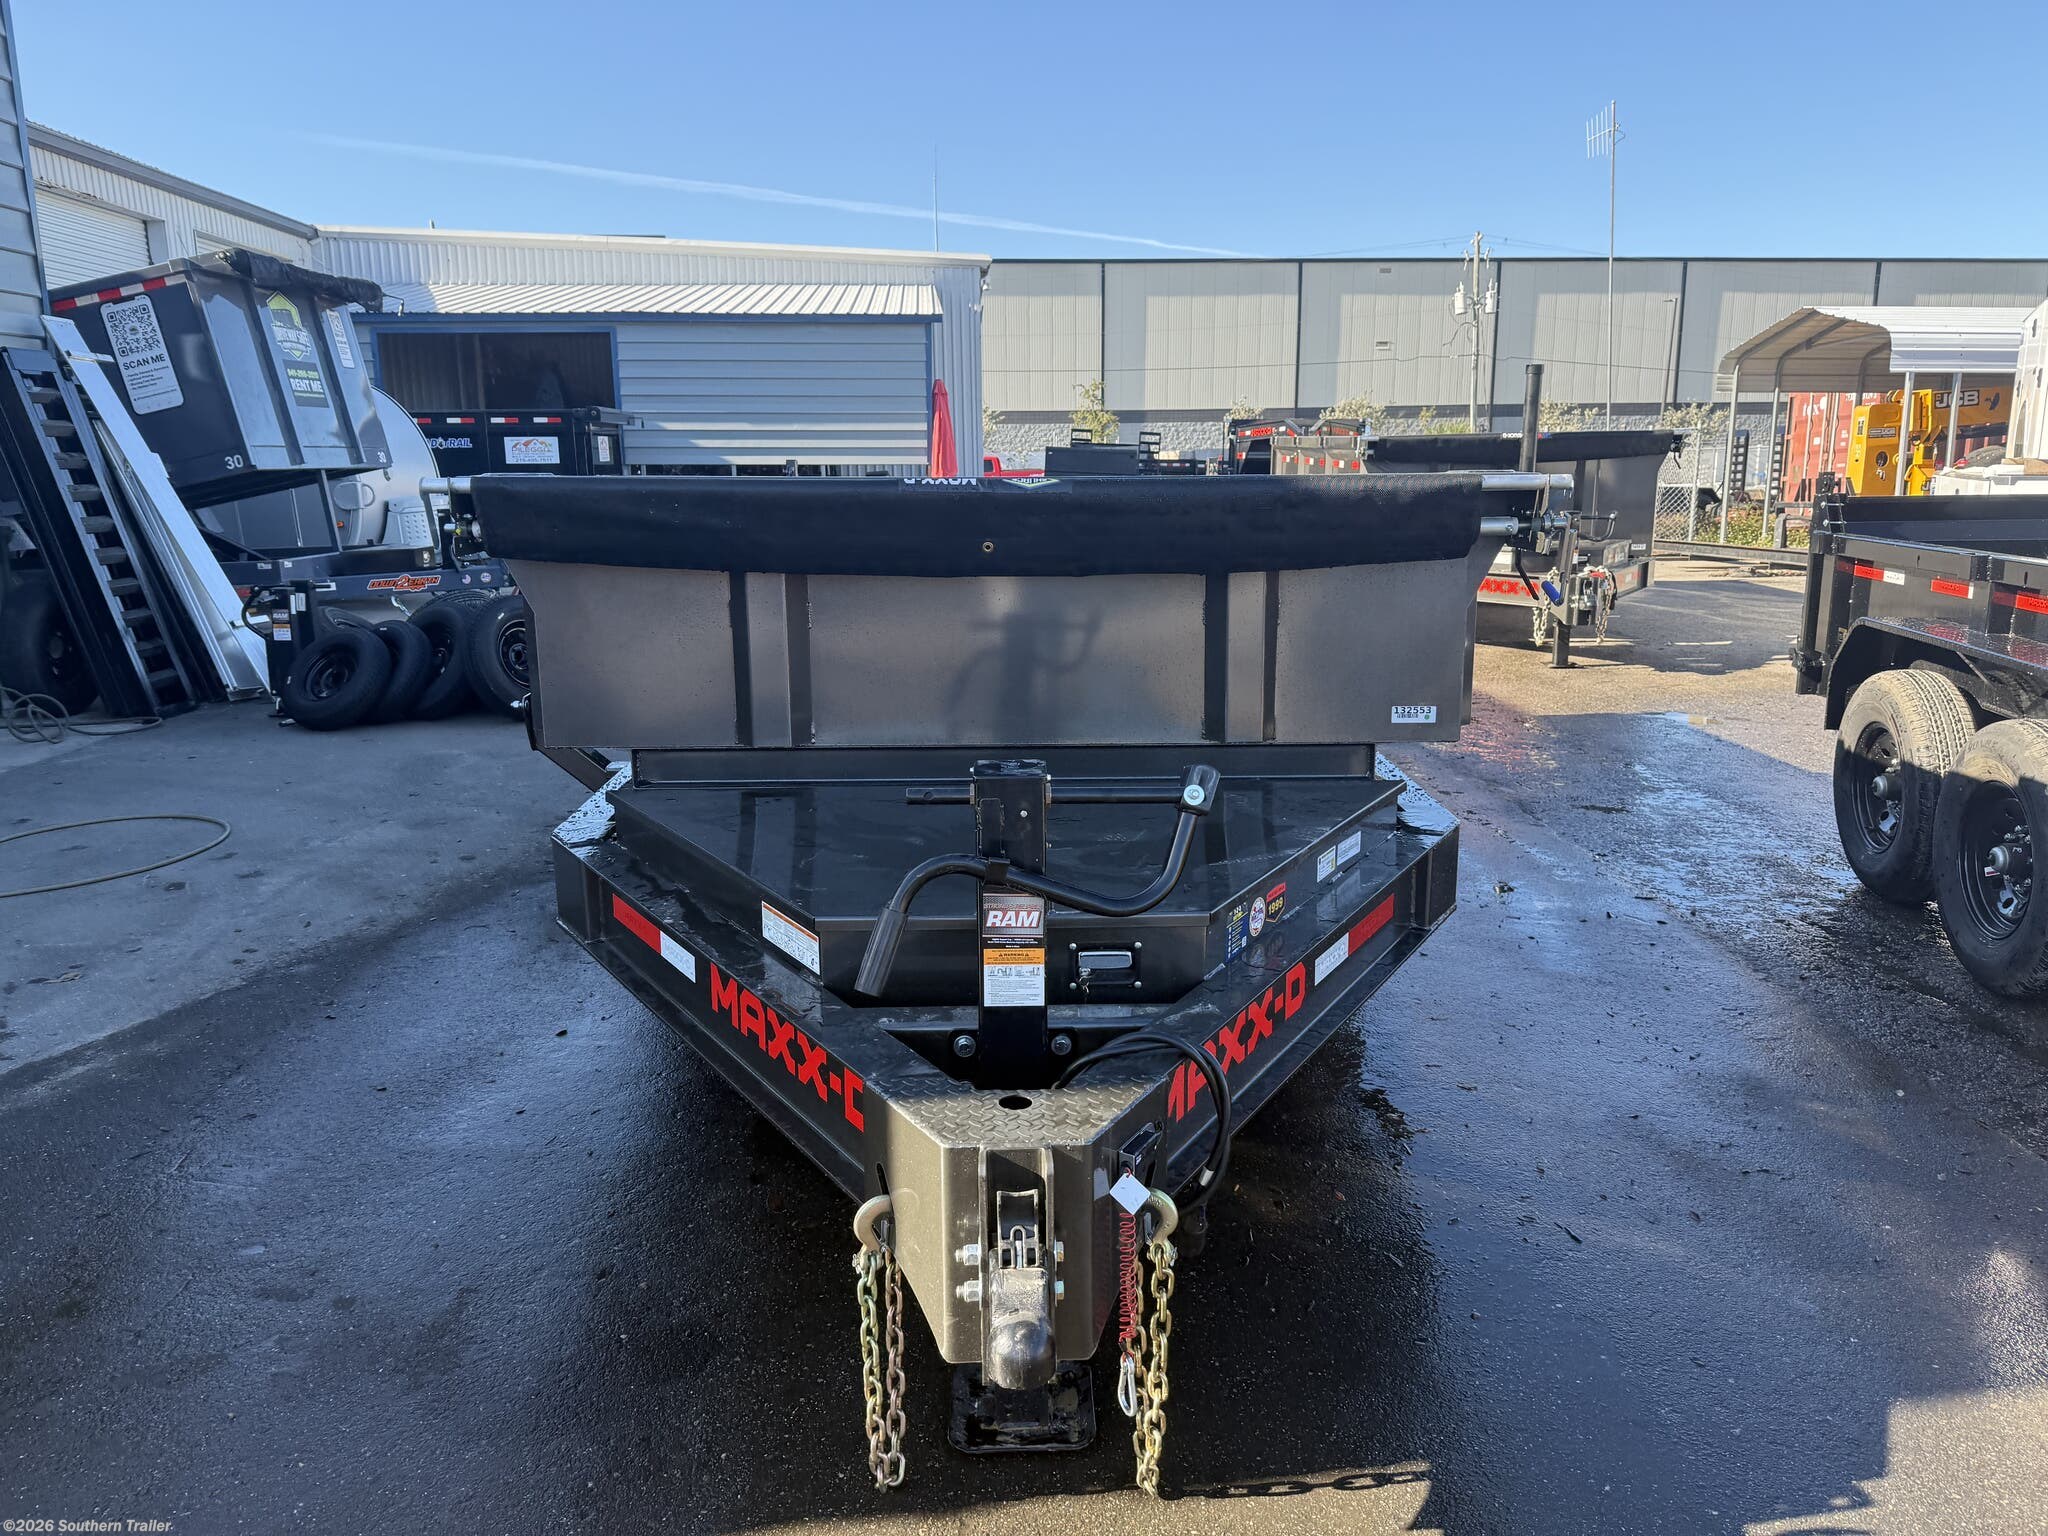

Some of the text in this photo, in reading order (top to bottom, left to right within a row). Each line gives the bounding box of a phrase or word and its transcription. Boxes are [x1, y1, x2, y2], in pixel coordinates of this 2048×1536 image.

[122, 356, 150, 371] SCAN
[152, 353, 167, 365] ME
[289, 378, 324, 393] RENT ME
[224, 454, 245, 471] 30
[377, 450, 387, 464] 30
[1393, 706, 1432, 714] 132553
[1267, 896, 1284, 916] 1999
[986, 910, 1041, 929] RAM
